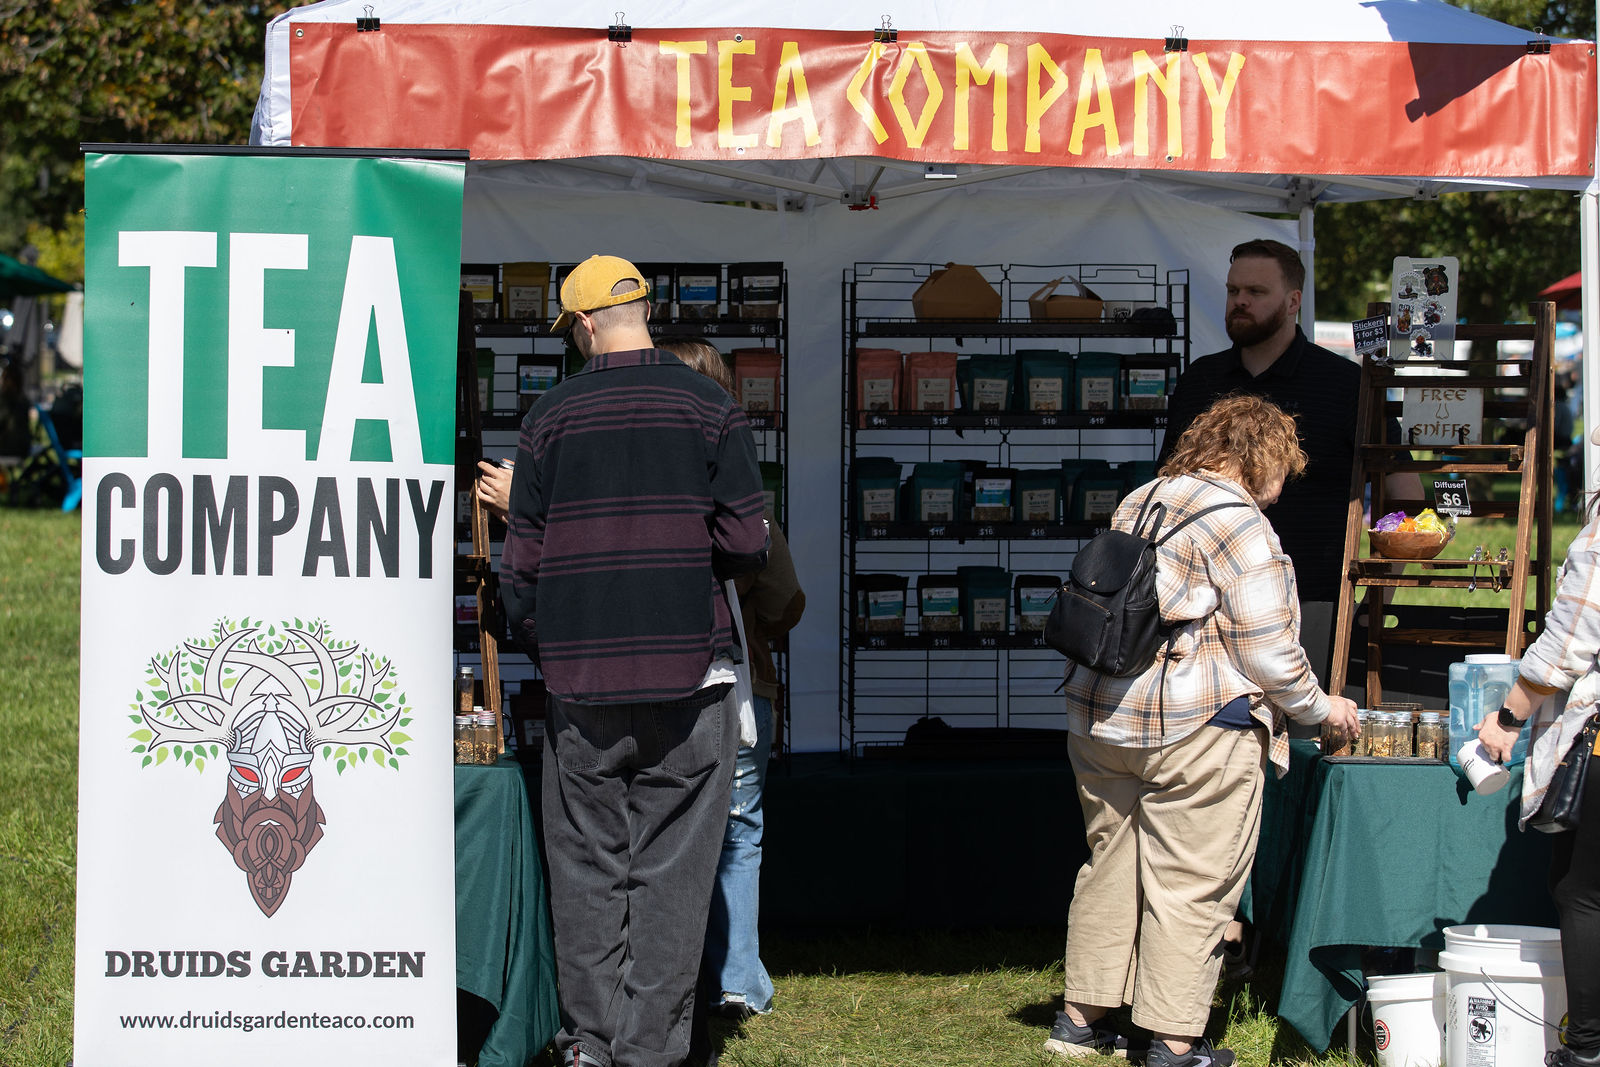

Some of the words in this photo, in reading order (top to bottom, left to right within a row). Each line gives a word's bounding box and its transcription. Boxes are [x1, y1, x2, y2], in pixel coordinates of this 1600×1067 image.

[659, 40, 821, 149] TEA
[846, 42, 1246, 160] COMPANY
[1353, 319, 1384, 331] Stickers
[1362, 330, 1373, 338] for
[118, 231, 425, 463] TEA
[1420, 388, 1467, 403] FREE
[1434, 481, 1464, 489] Diffuser
[1442, 493, 1462, 506] $6
[96, 472, 445, 579] COMPANY
[105, 950, 251, 978] DRUIDS
[261, 951, 426, 978] GARDEN
[119, 1010, 415, 1033] www.druidsgardenteaco.com
